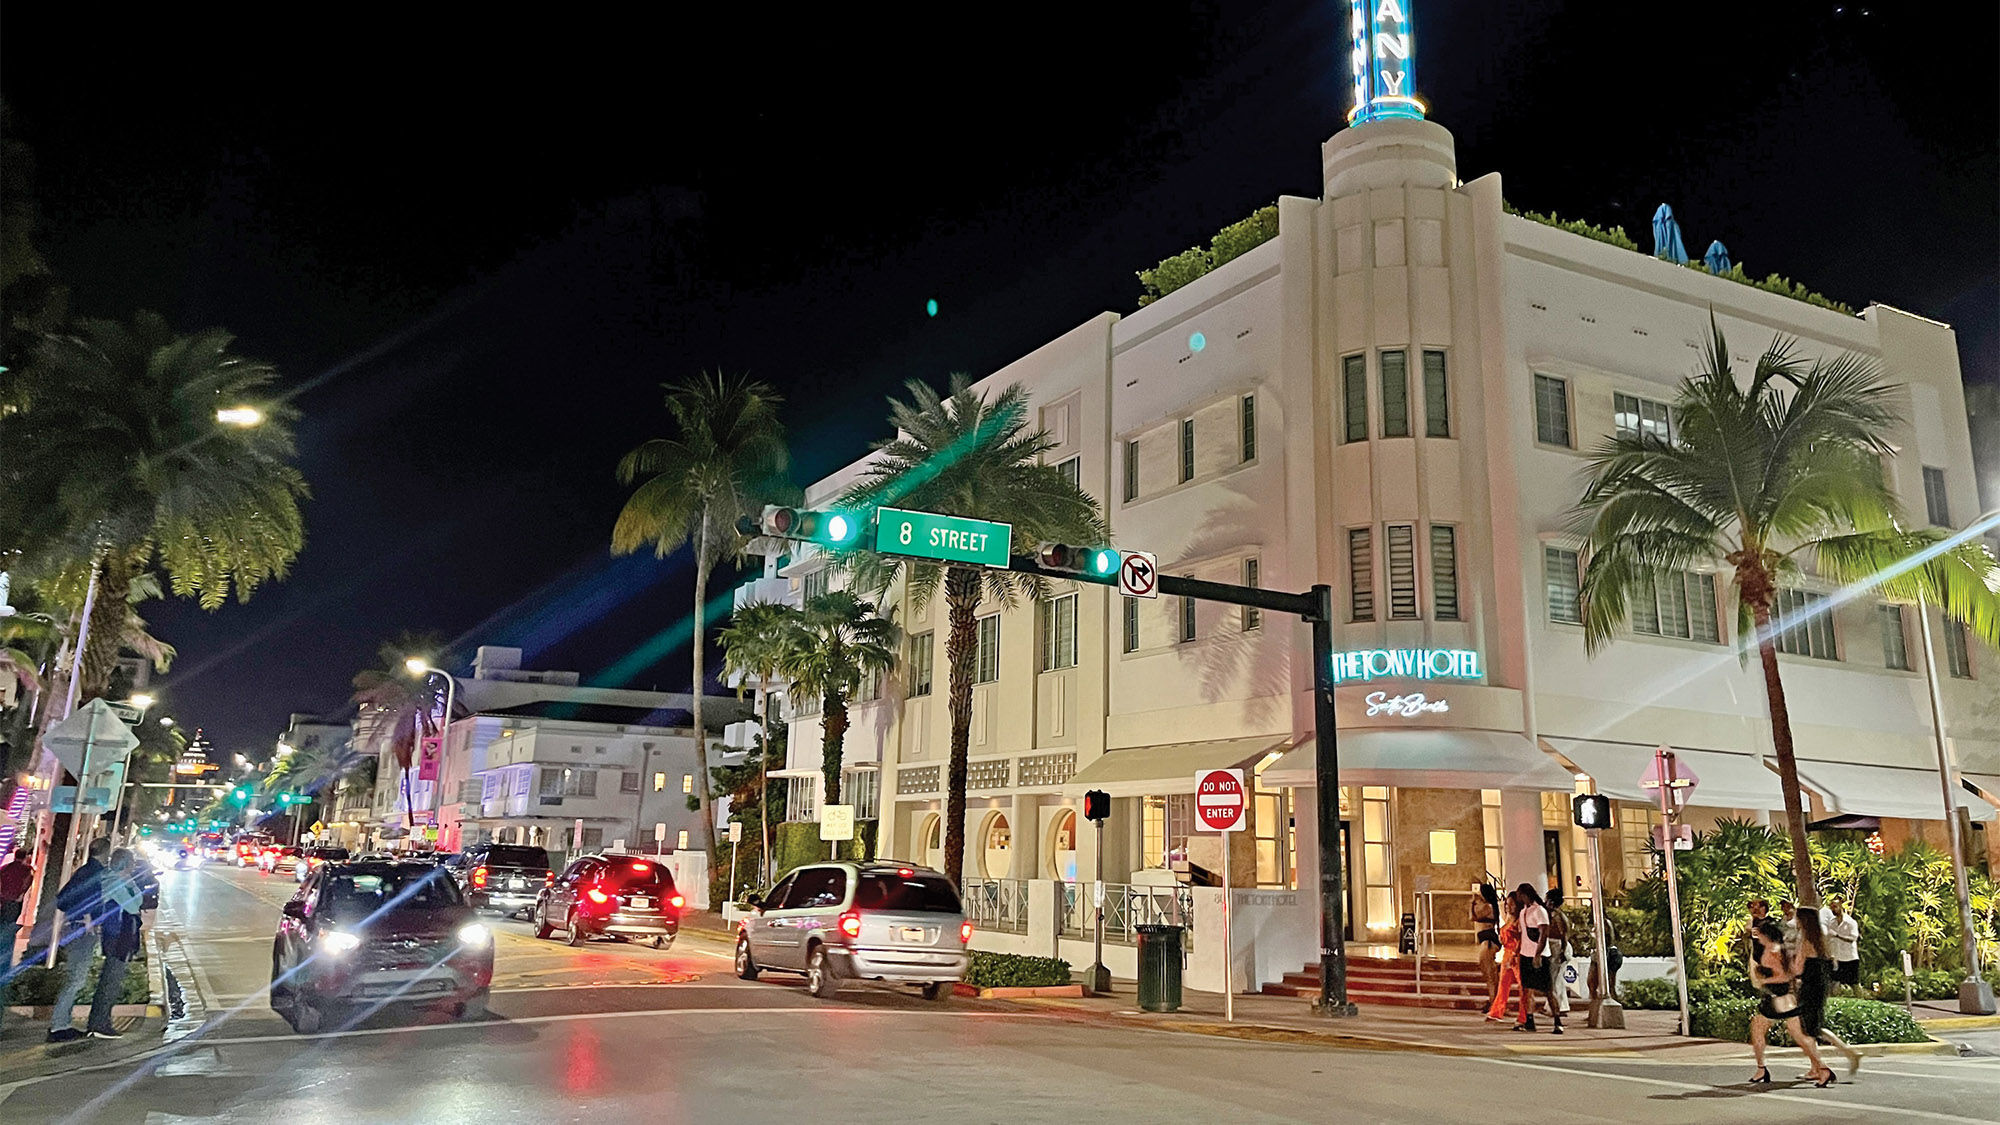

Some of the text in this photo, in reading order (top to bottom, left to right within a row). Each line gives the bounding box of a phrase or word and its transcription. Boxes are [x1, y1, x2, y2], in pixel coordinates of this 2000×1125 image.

[899, 521, 988, 552] 8 STREET
[1331, 648, 1482, 682] THE TONY HOTEL
[1203, 781, 1236, 792] DO NOT
[1206, 808, 1234, 818] ENTER
